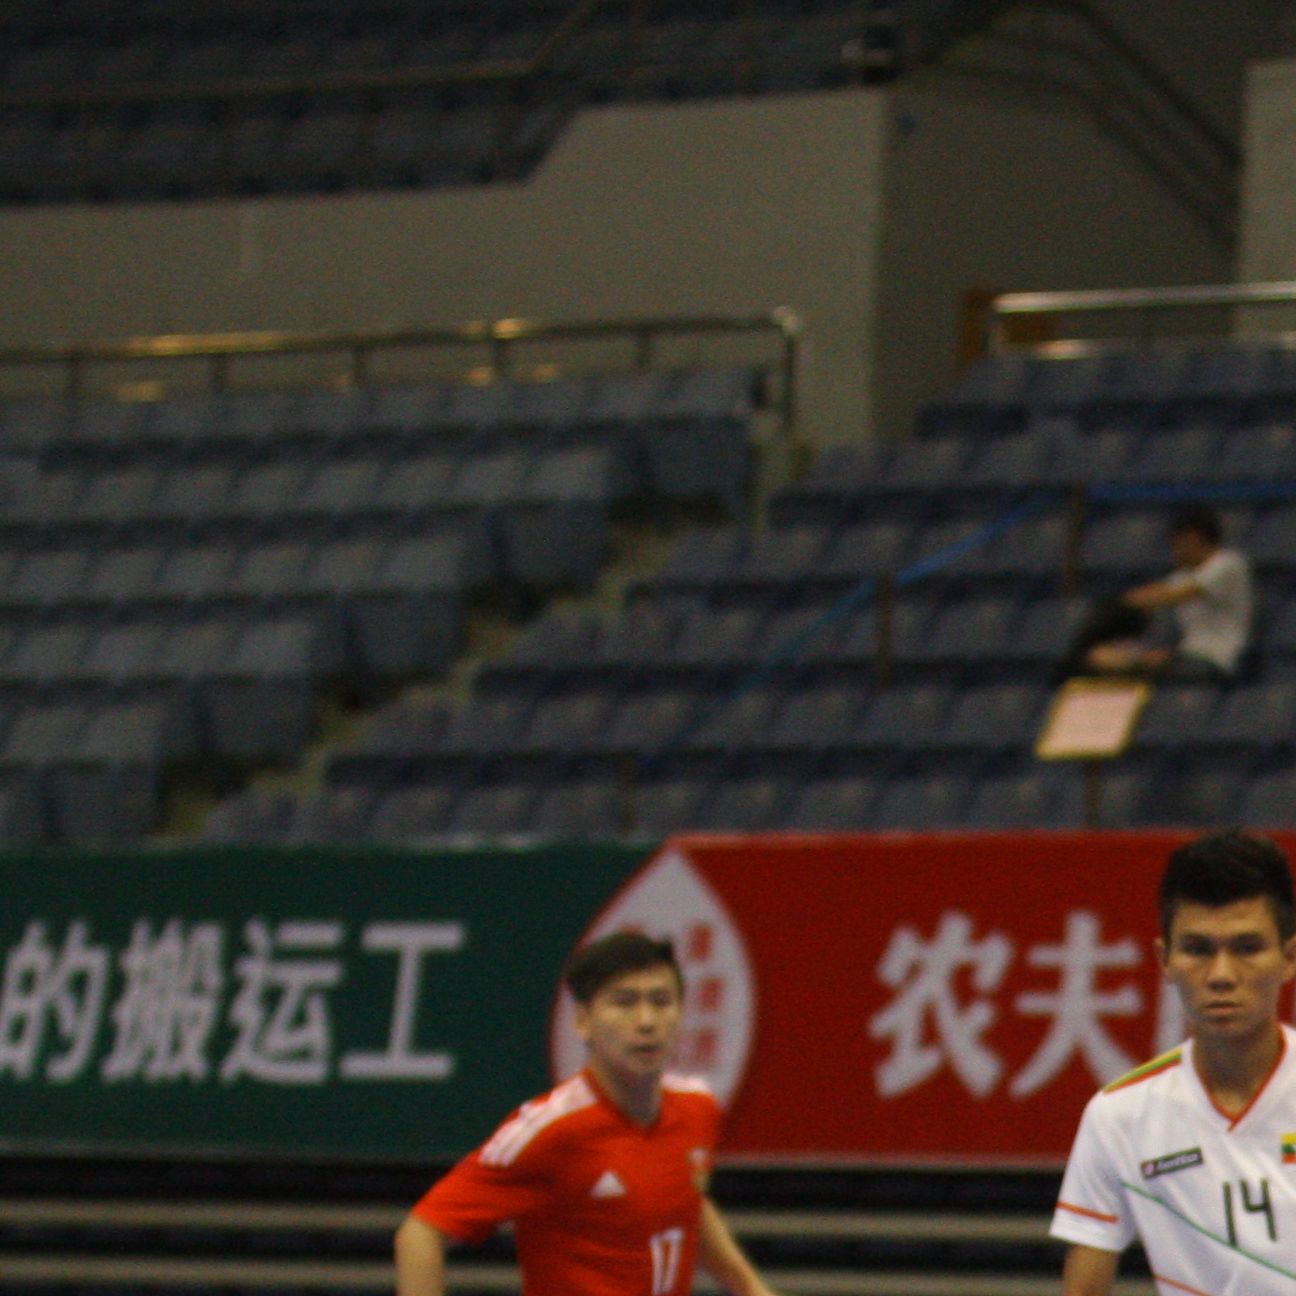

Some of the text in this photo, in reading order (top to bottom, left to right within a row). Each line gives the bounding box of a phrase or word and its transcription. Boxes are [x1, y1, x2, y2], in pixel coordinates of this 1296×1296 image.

[0, 918, 464, 1084] 的搬运工
[1222, 1178, 1277, 1248] 14
